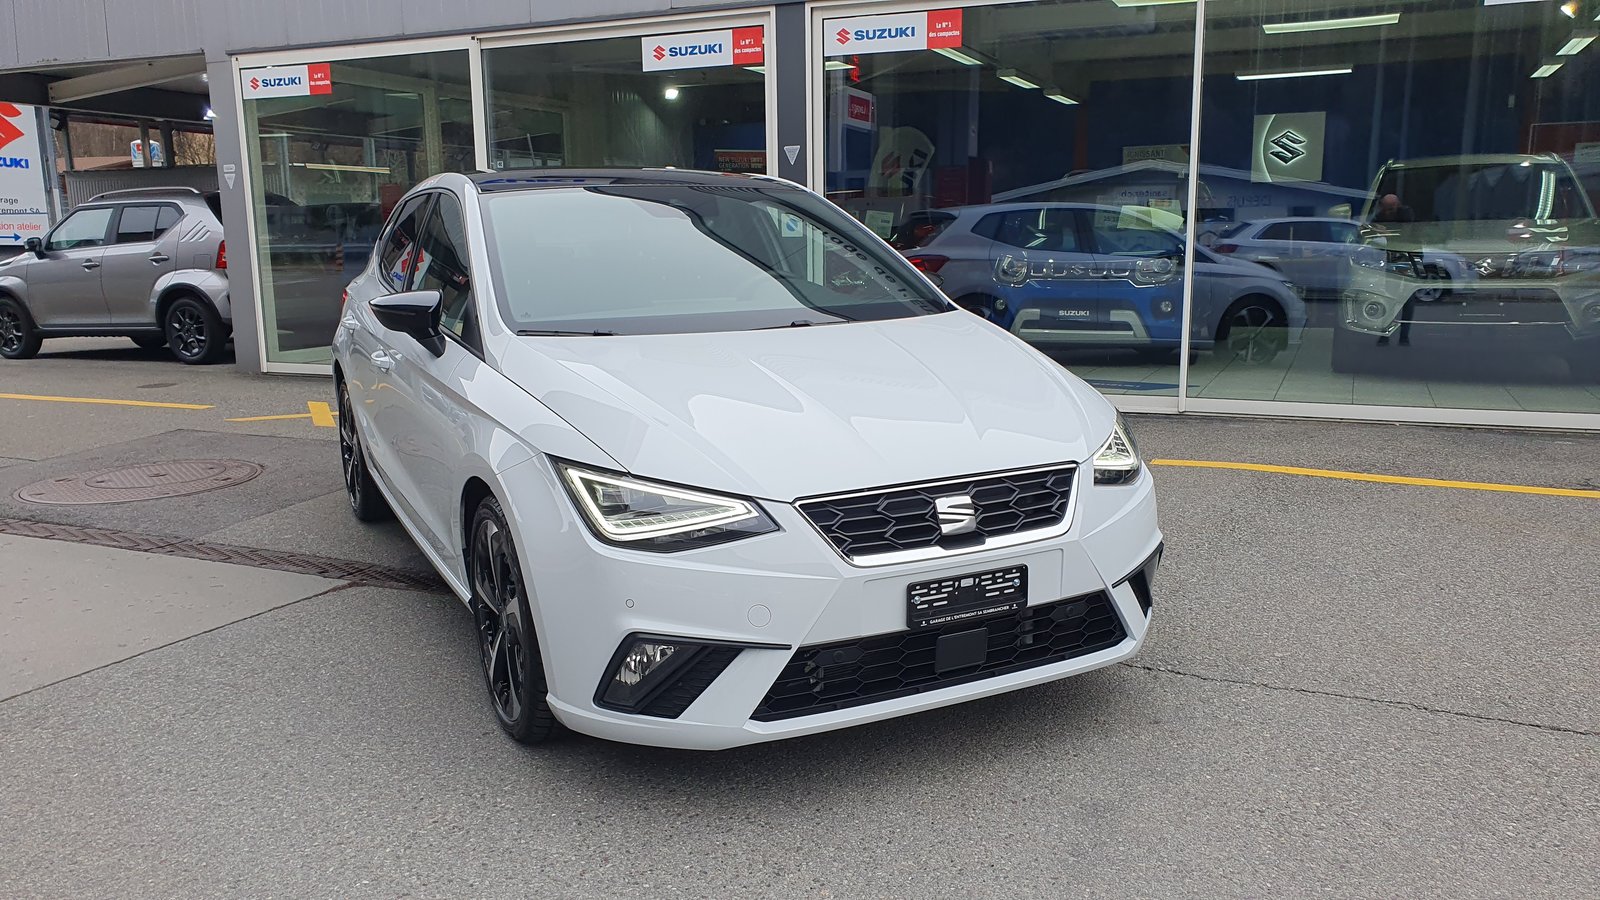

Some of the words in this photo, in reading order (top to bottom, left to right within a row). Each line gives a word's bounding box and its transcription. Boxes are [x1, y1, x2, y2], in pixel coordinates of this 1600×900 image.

[854, 26, 916, 41] SUZUKI
[937, 30, 960, 38] compactes
[668, 43, 723, 57] SUZUKI
[261, 76, 302, 88] SUZUKI
[16, 221, 41, 231] atelier
[929, 617, 946, 625] GARAGE
